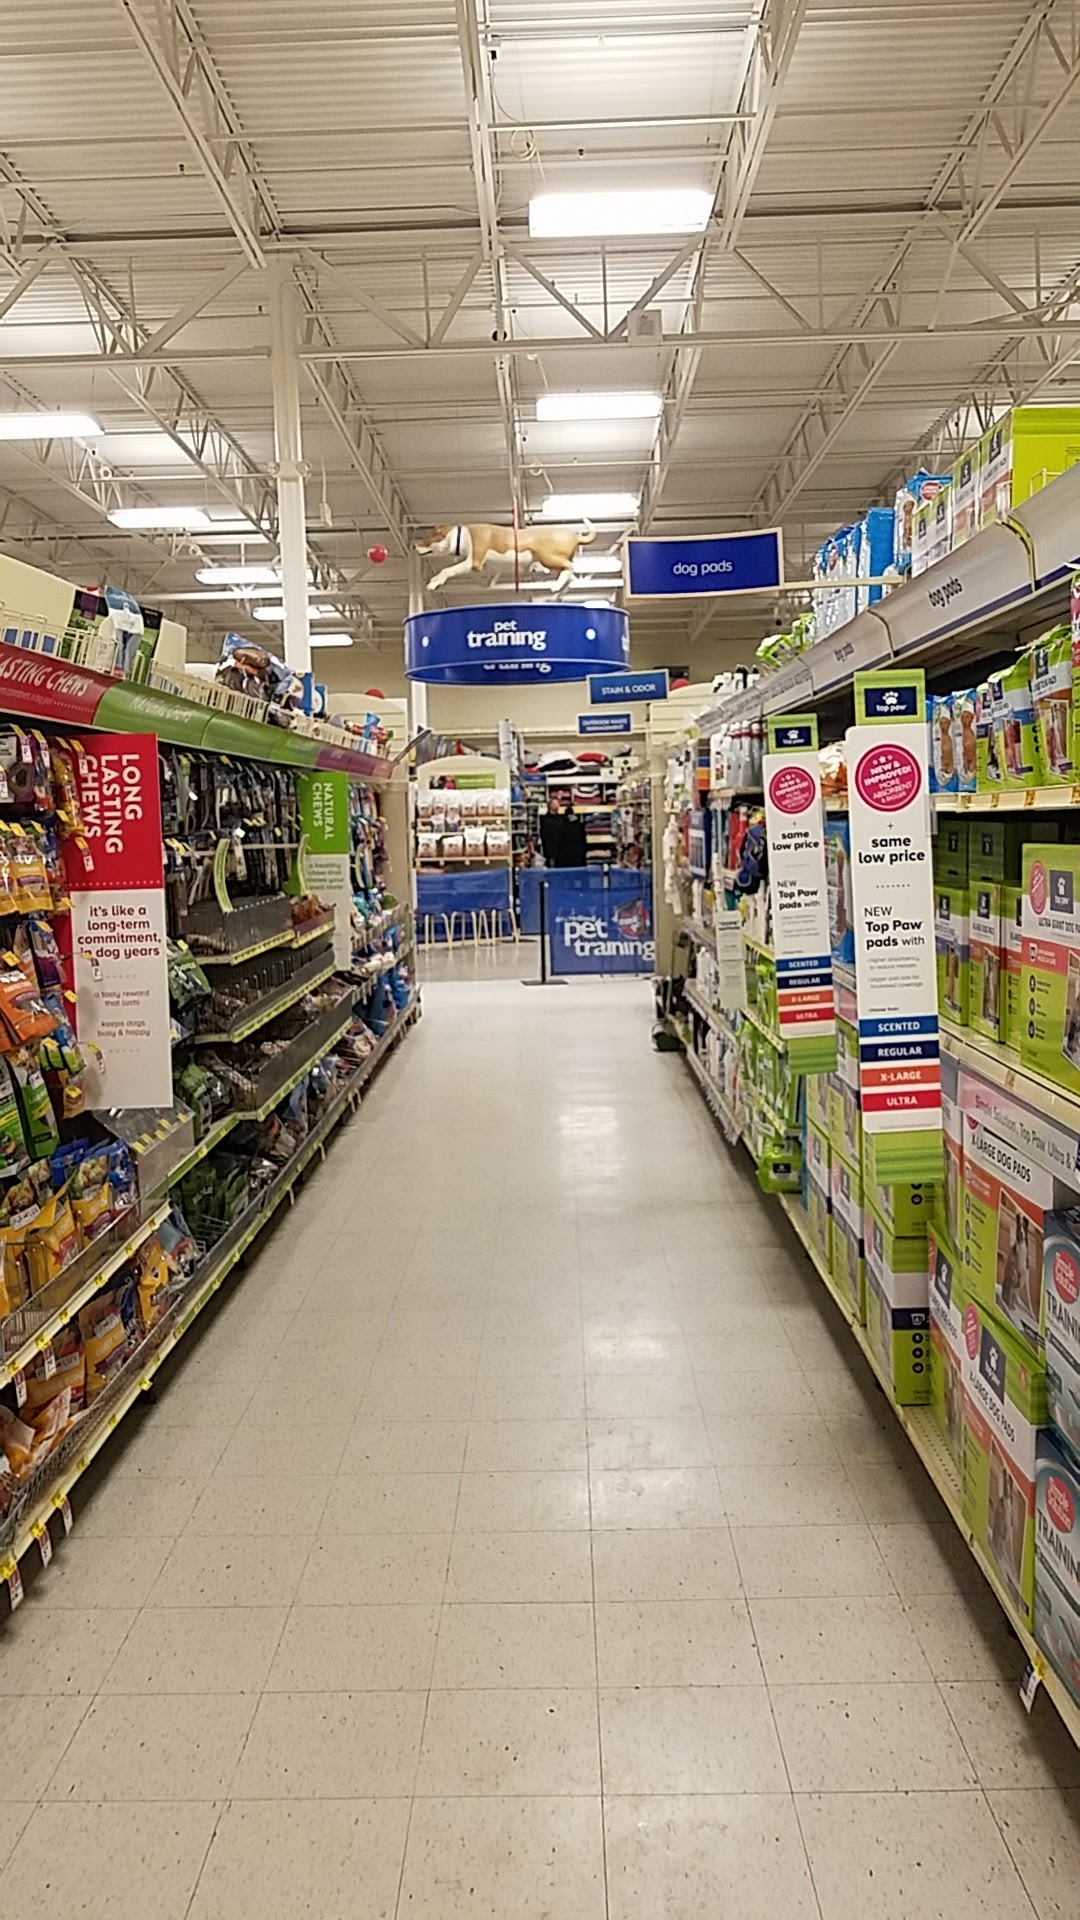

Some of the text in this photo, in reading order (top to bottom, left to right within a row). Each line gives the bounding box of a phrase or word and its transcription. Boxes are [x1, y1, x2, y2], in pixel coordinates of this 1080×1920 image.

[673, 560, 733, 576] dog pads
[928, 576, 963, 607] dog pads
[494, 620, 517, 633] pet
[467, 630, 547, 650] training
[46, 670, 94, 697] CHEWS
[601, 687, 624, 695] STAIN
[632, 684, 656, 693] ODOR
[876, 703, 907, 713] top paw
[871, 763, 892, 775] NEW
[864, 765, 912, 786] IMPROVED!
[121, 754, 143, 820] LONG
[879, 778, 900, 790] MORE
[81, 755, 101, 838] CHEWS
[873, 781, 912, 800] ABSORBENT
[101, 755, 123, 854] LASTING
[312, 782, 322, 827] CHEWS
[323, 782, 334, 840] NATURAL
[781, 831, 810, 839] same
[772, 840, 819, 851] low price
[871, 837, 911, 848] same
[858, 849, 925, 865] low price
[777, 880, 797, 888] NEW
[779, 890, 795, 899] Top
[89, 905, 147, 917] it's like a
[779, 900, 820, 911] pads with
[864, 906, 892, 917] NEW
[87, 920, 150, 931] long-term
[865, 921, 889, 934] Top
[893, 919, 923, 931] Paw
[564, 918, 608, 946] pet
[77, 932, 162, 945] commitment,
[866, 936, 925, 950] pads with
[96, 947, 120, 959] dog
[123, 947, 160, 959] years
[574, 938, 655, 961] training
[788, 960, 819, 968] SCENTED
[789, 977, 820, 986] REGULAR
[101, 991, 121, 1000] tasty
[795, 1011, 818, 1020] ULTRA
[101, 1020, 145, 1029] keeps dogs
[878, 1021, 921, 1032] SCENTED
[97, 1030, 116, 1038] busy
[126, 1028, 151, 1037] happy
[878, 1046, 922, 1057] REGULAR
[880, 1071, 922, 1082] X-LARGE
[887, 1096, 918, 1106] ULTRA
[1019, 1121, 1030, 1145] Top
[1032, 1130, 1045, 1152] Paw
[972, 1134, 996, 1160] X-LARGE
[997, 1149, 1011, 1170] DOG
[1013, 1160, 1031, 1182] PADS
